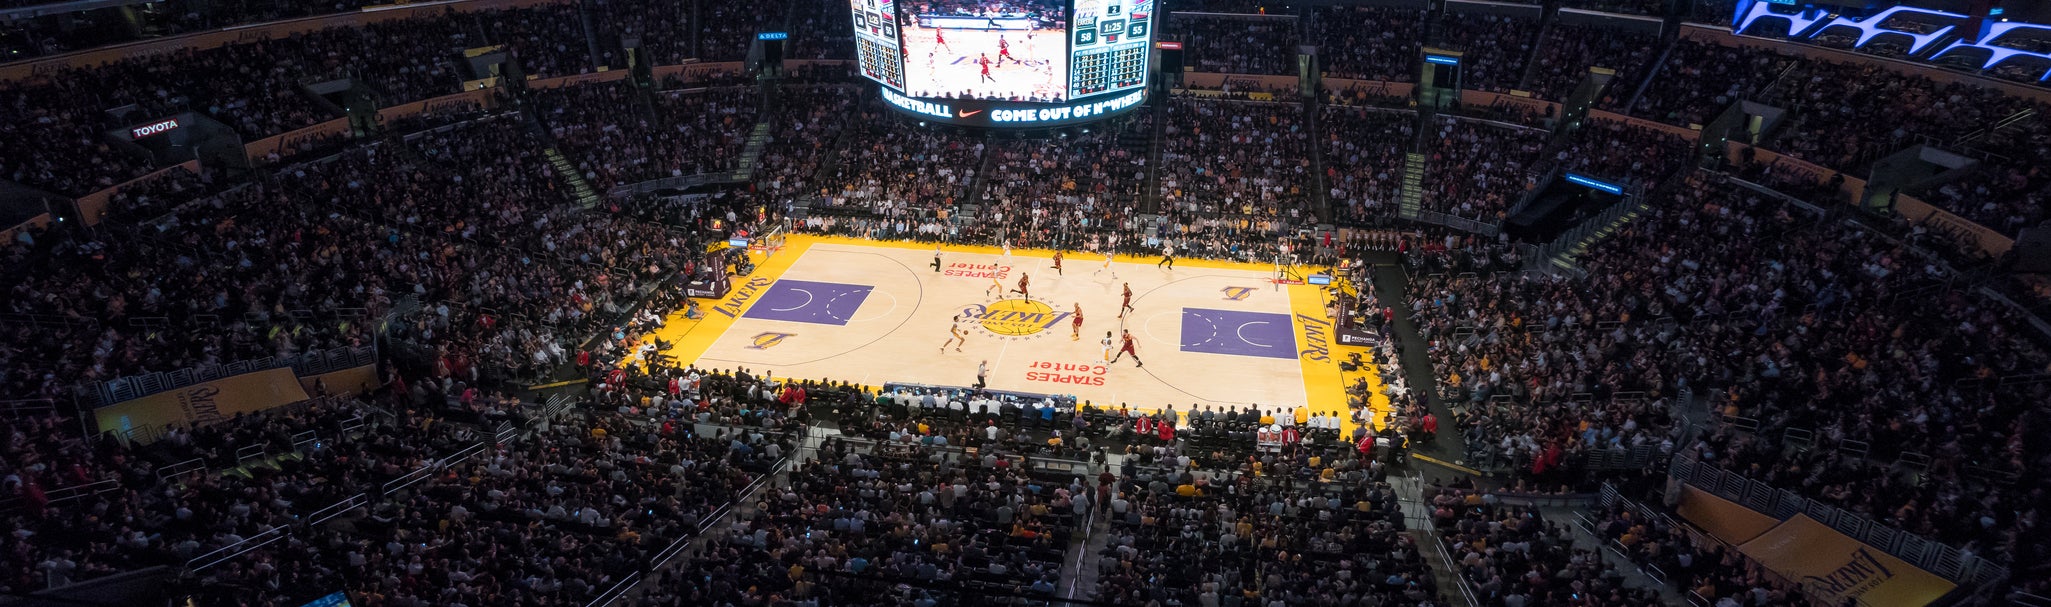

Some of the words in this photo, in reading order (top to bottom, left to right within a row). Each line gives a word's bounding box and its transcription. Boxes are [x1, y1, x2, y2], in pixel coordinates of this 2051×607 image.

[1104, 22, 1122, 33] 1:25
[1132, 25, 1143, 35] 55
[1080, 32, 1092, 42] 58
[990, 109, 1037, 122] COME
[1038, 107, 1071, 121] OUT
[1073, 105, 1091, 118] OF
[133, 120, 178, 137] TOYOTA
[1569, 176, 1594, 186] AMERICAN
[1595, 182, 1619, 192] EXPRESS
[713, 274, 775, 319] LAKERS
[955, 303, 1070, 329] LAKERS
[1296, 311, 1332, 365] LAKERS
[1029, 361, 1107, 376] Center
[1026, 371, 1105, 386] STAPLES
